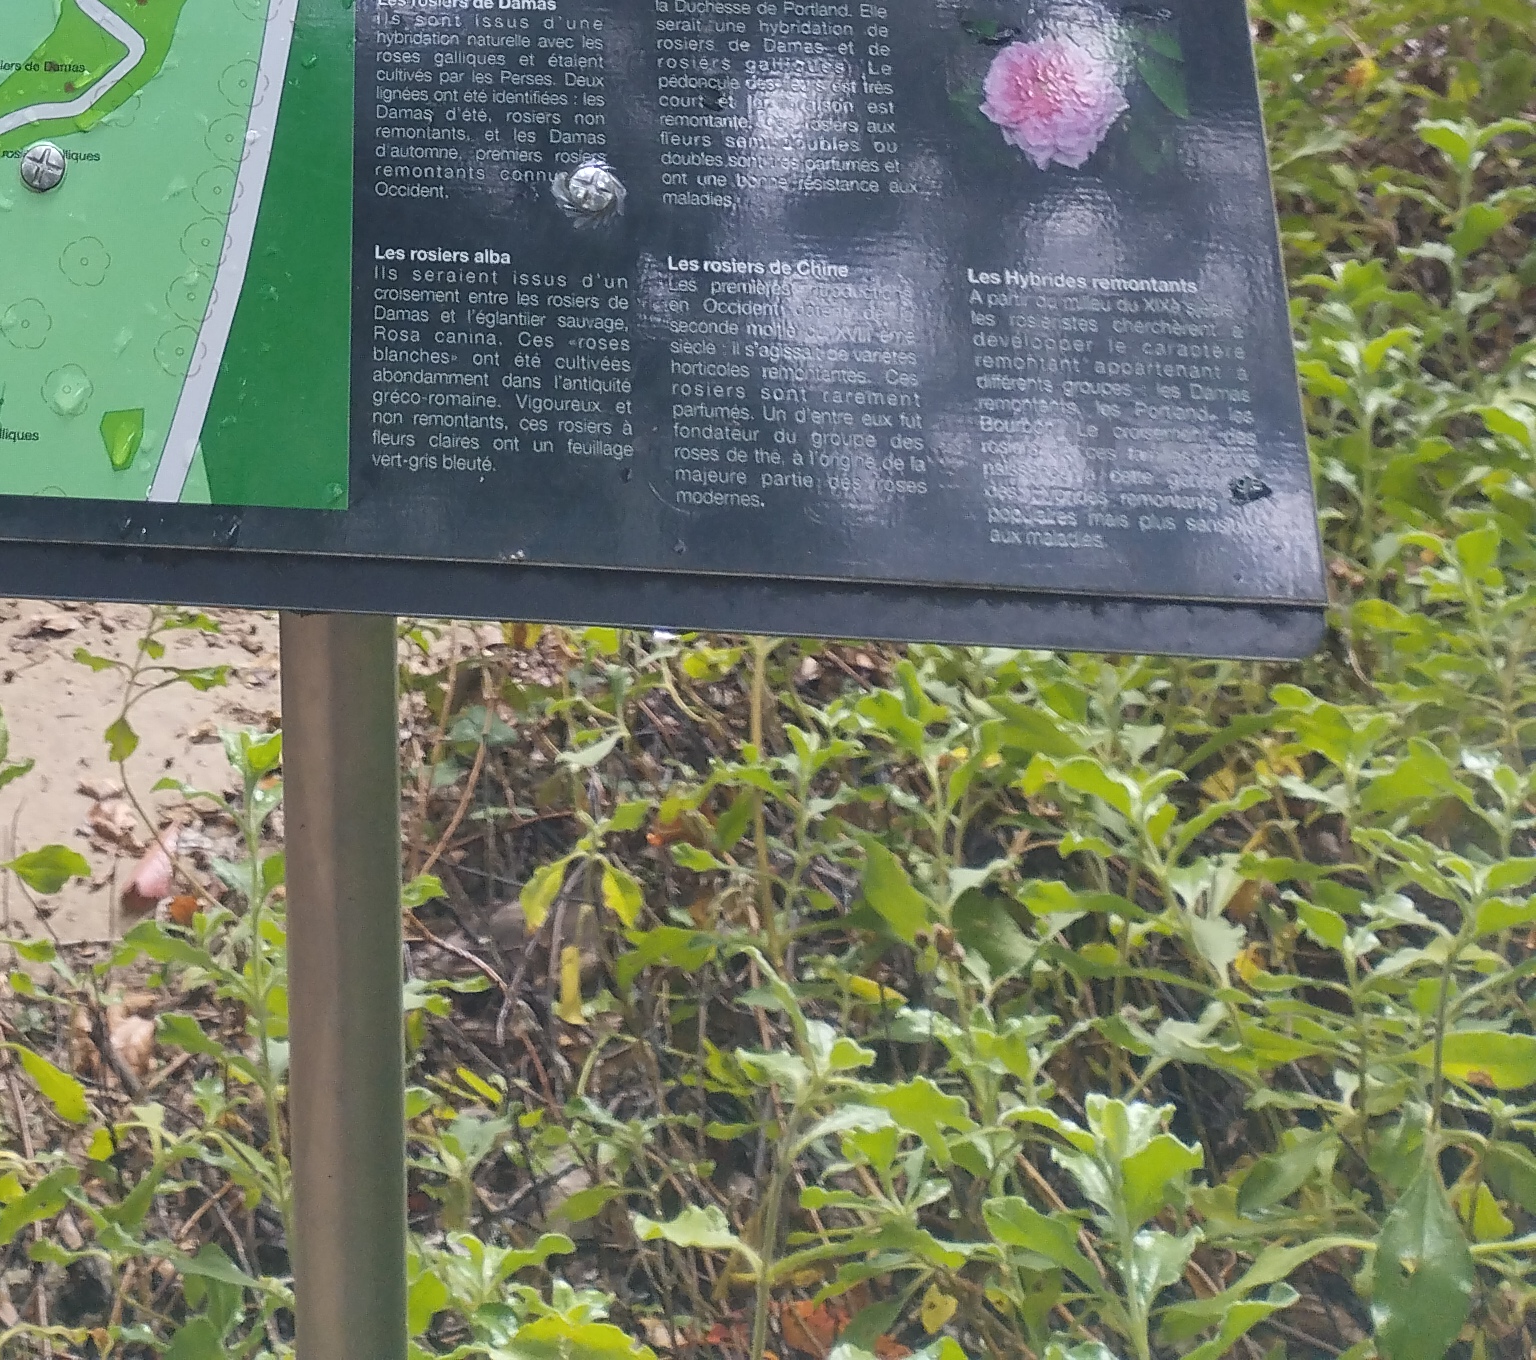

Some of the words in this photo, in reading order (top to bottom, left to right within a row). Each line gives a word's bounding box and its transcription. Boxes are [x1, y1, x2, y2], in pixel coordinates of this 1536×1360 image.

[25, 62, 39, 71] de
[376, 69, 432, 82] cultivés
[440, 71, 464, 84] par
[472, 71, 492, 83] les
[500, 71, 556, 86] Perses.
[564, 73, 604, 87] Deux
[375, 245, 405, 259] Les
[410, 247, 469, 262] rosiers
[474, 249, 510, 264] alba
[375, 266, 398, 280] Ils
[413, 268, 497, 284] seraient
[513, 272, 567, 286] issus
[582, 274, 628, 288] d'un
[668, 256, 698, 271] Les
[704, 259, 764, 274] rosiers
[770, 260, 791, 275] de
[796, 260, 848, 277] Chine
[968, 268, 1001, 284] Les
[1005, 271, 1085, 289] Hybrides
[1092, 274, 1198, 294] remontants
[672, 382, 745, 399] rosiers
[762, 388, 806, 400] sont
[823, 390, 920, 408] rarement
[373, 431, 415, 446] fleurs
[429, 432, 479, 449] claires
[493, 437, 519, 450] ont
[533, 440, 553, 452] un
[567, 441, 634, 459] feuillage
[372, 454, 437, 471] vert-gris
[443, 455, 496, 472] bleuté.
